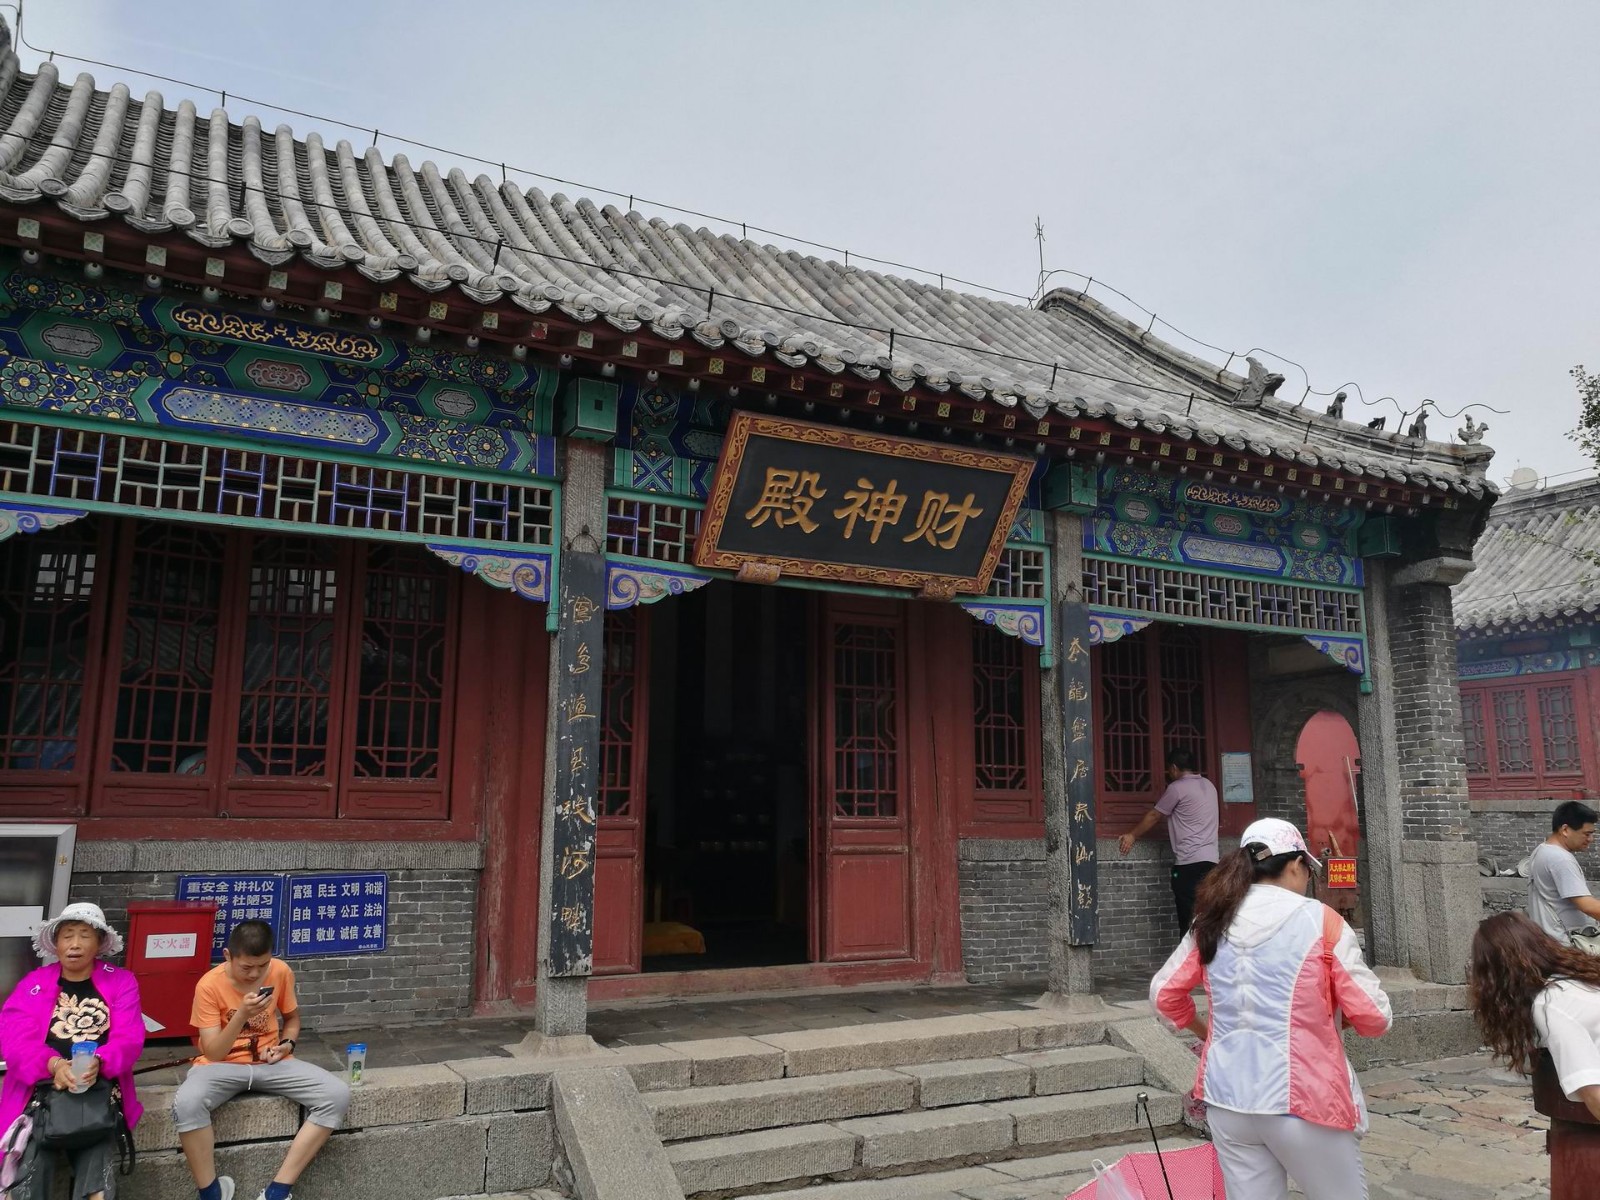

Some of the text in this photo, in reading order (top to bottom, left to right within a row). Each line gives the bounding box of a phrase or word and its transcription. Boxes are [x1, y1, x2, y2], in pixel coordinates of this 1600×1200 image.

[186, 880, 275, 894] 重安全 讲礼仪
[293, 881, 383, 899] 富强 民主 文明 和谐
[232, 894, 273, 906] 杜陋习
[231, 908, 272, 920] 明事理
[293, 902, 382, 921] 自由 平等 公正 法治
[291, 923, 382, 944] 爱国 敬业 诚信 友善
[153, 937, 191, 950] 灭火器
